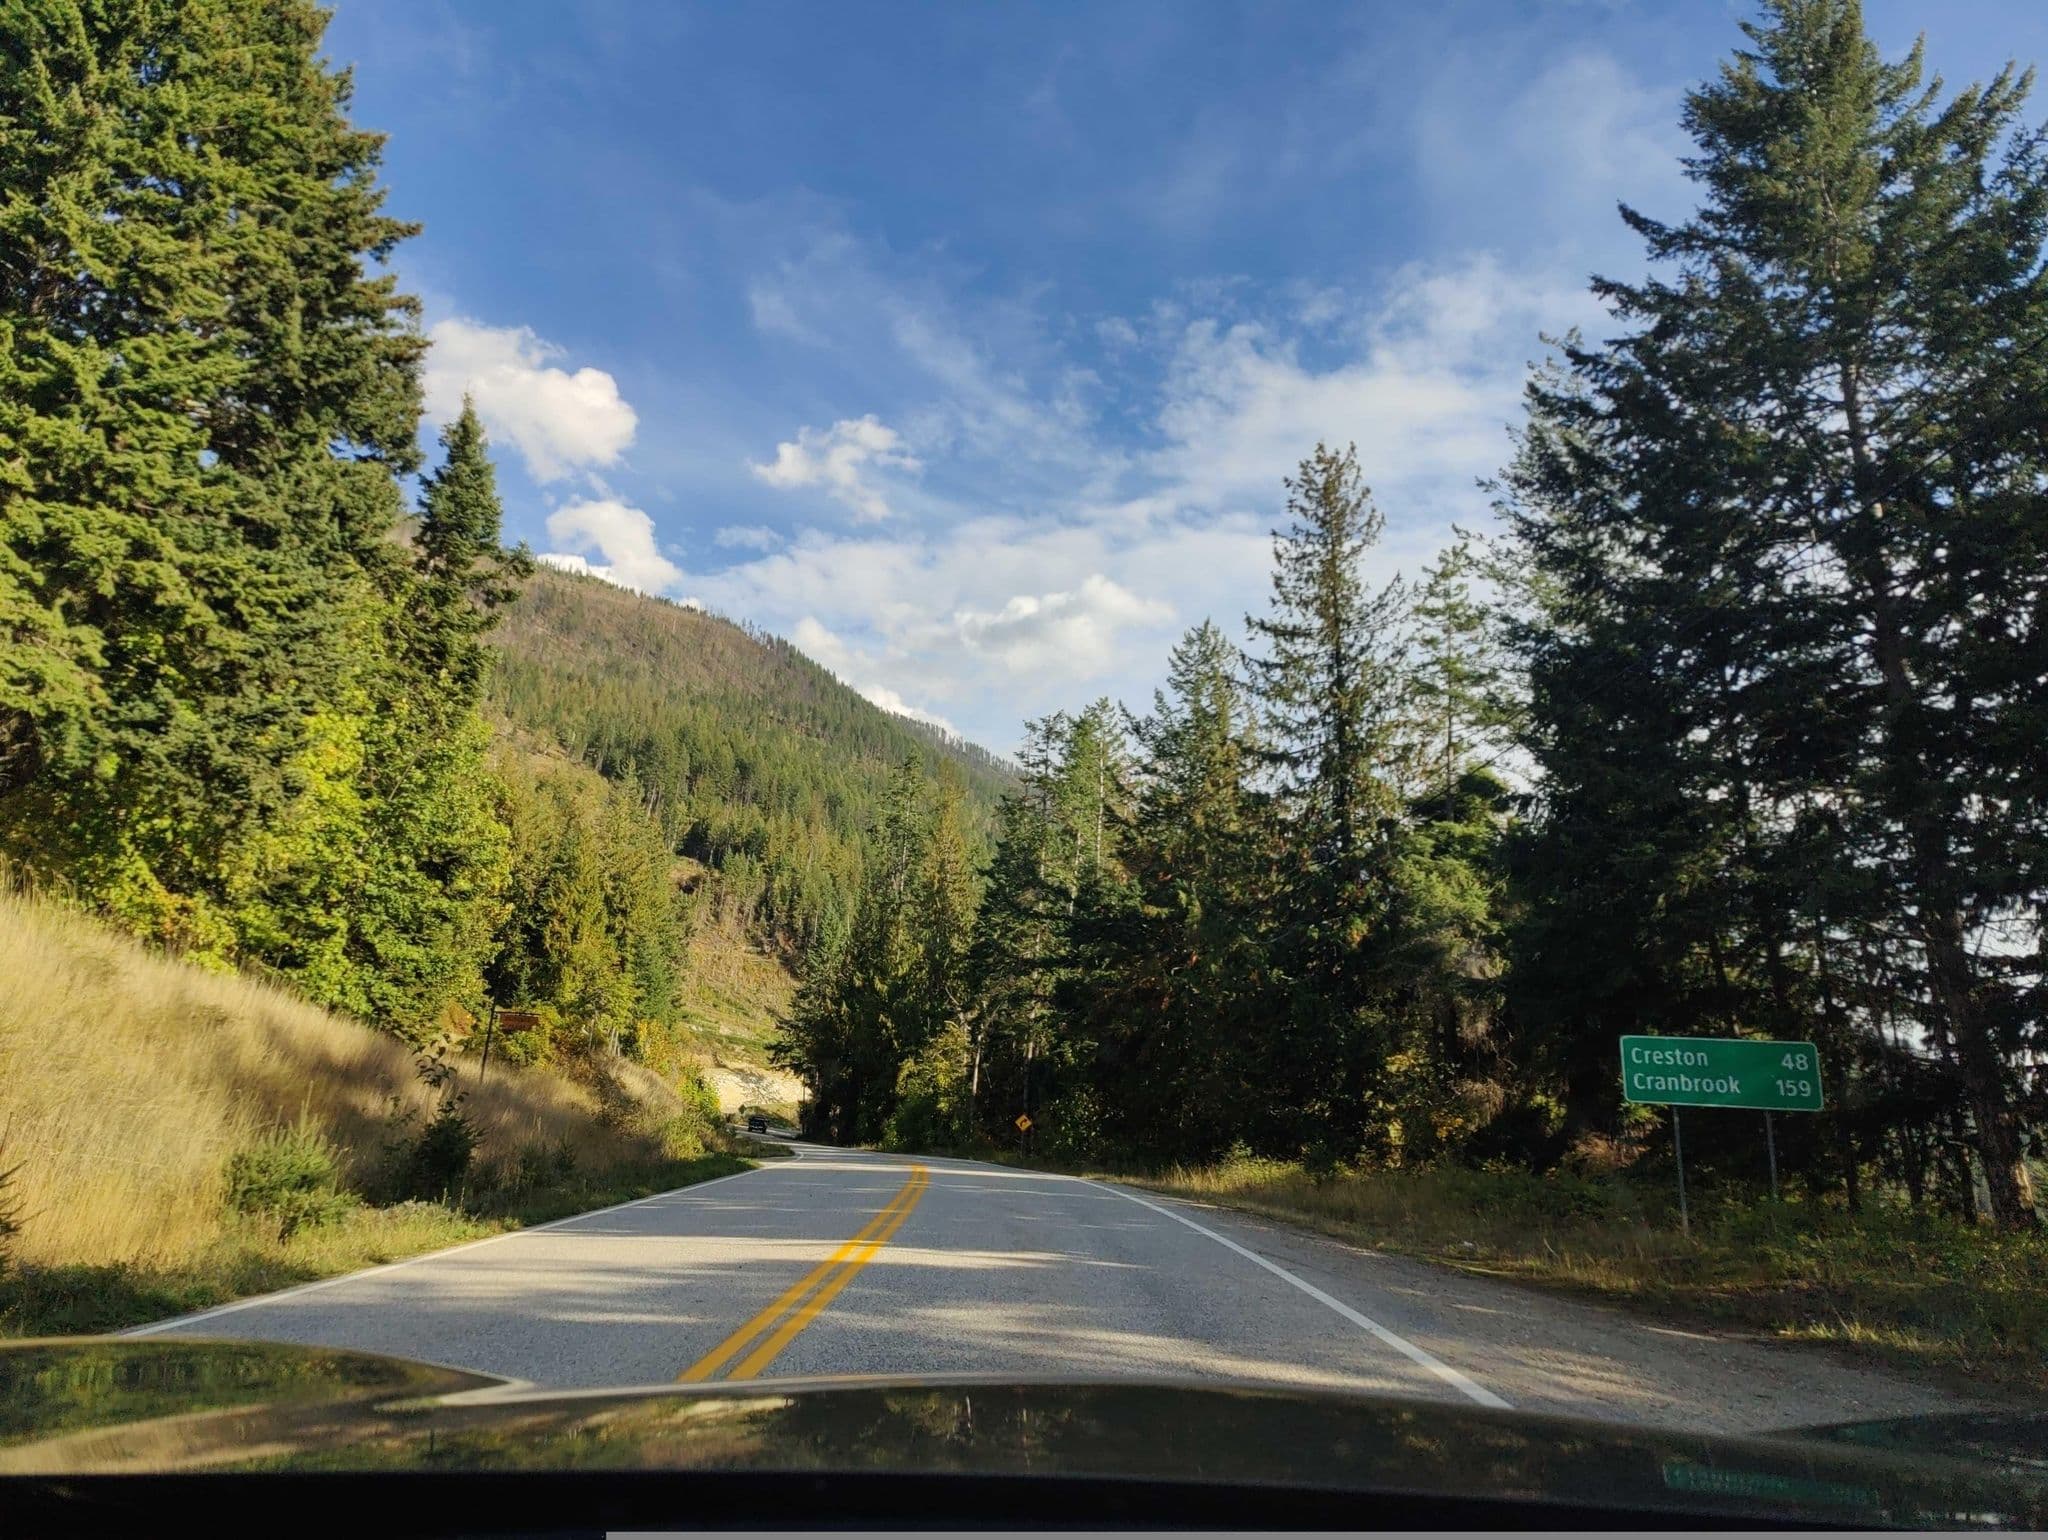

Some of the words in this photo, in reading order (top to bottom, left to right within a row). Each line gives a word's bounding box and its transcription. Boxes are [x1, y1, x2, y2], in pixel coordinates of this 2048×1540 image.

[1631, 1047, 1709, 1067] Creston
[1781, 1053, 1809, 1071] 48
[1633, 1073, 1741, 1094] Cranbrook
[1776, 1079, 1812, 1097] 159
